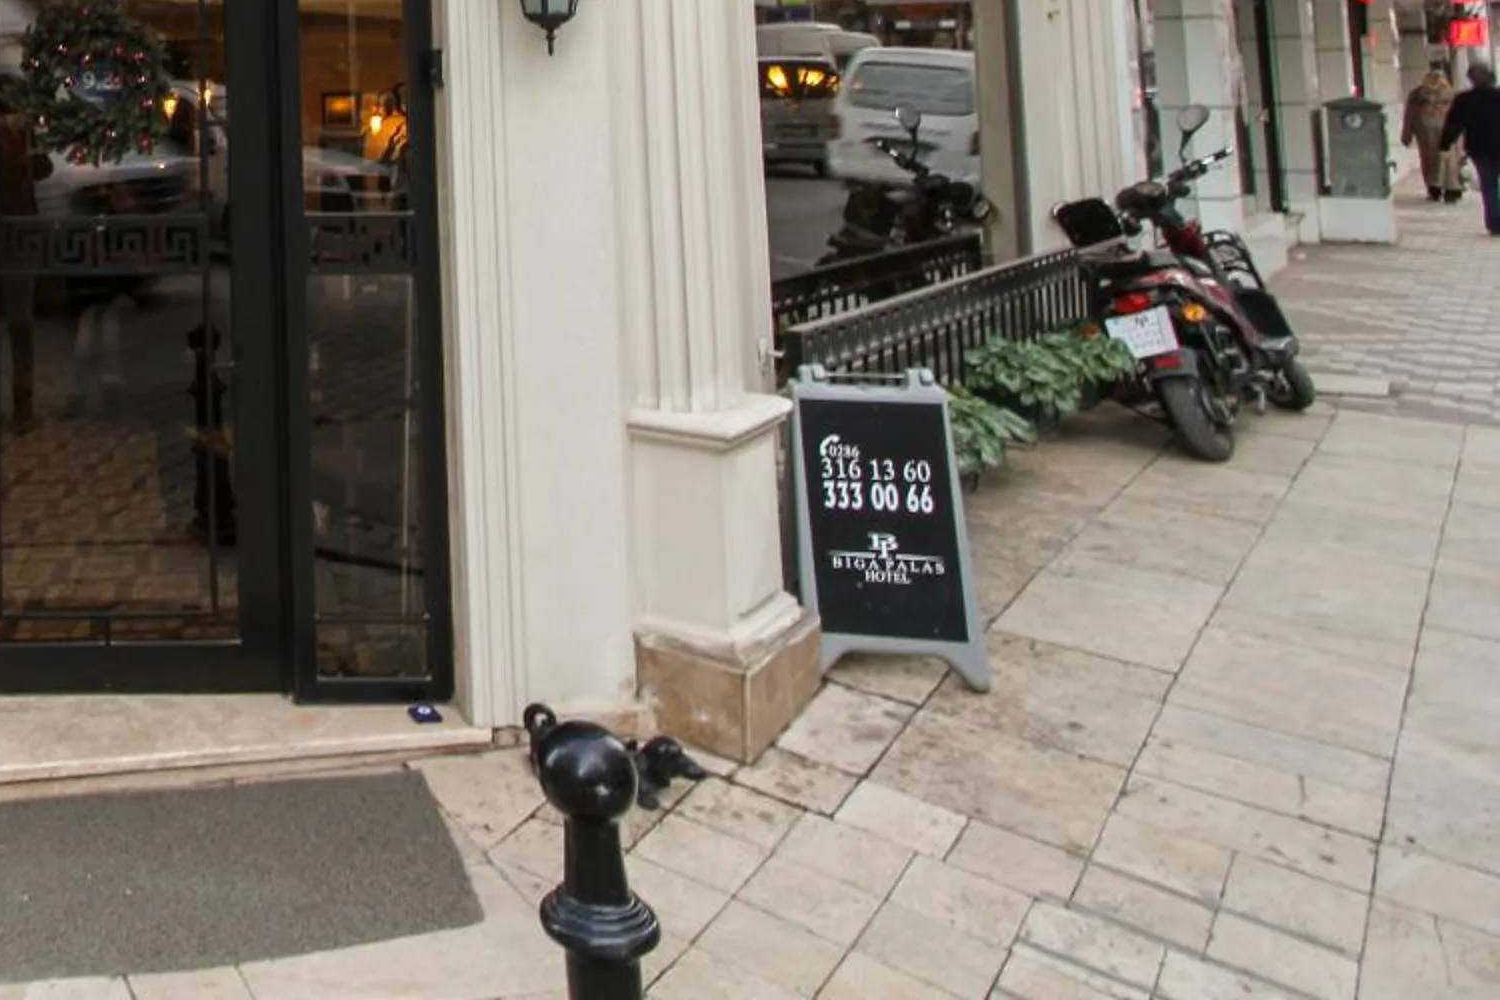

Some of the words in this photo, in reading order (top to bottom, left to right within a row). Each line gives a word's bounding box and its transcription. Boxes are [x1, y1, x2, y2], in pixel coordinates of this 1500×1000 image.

[821, 457, 861, 480] 316
[870, 459, 895, 481] 13
[903, 460, 931, 483] 60
[823, 480, 863, 510] 333
[871, 482, 899, 511] 00
[906, 484, 934, 514] 66
[865, 570, 911, 585] HOTEL
